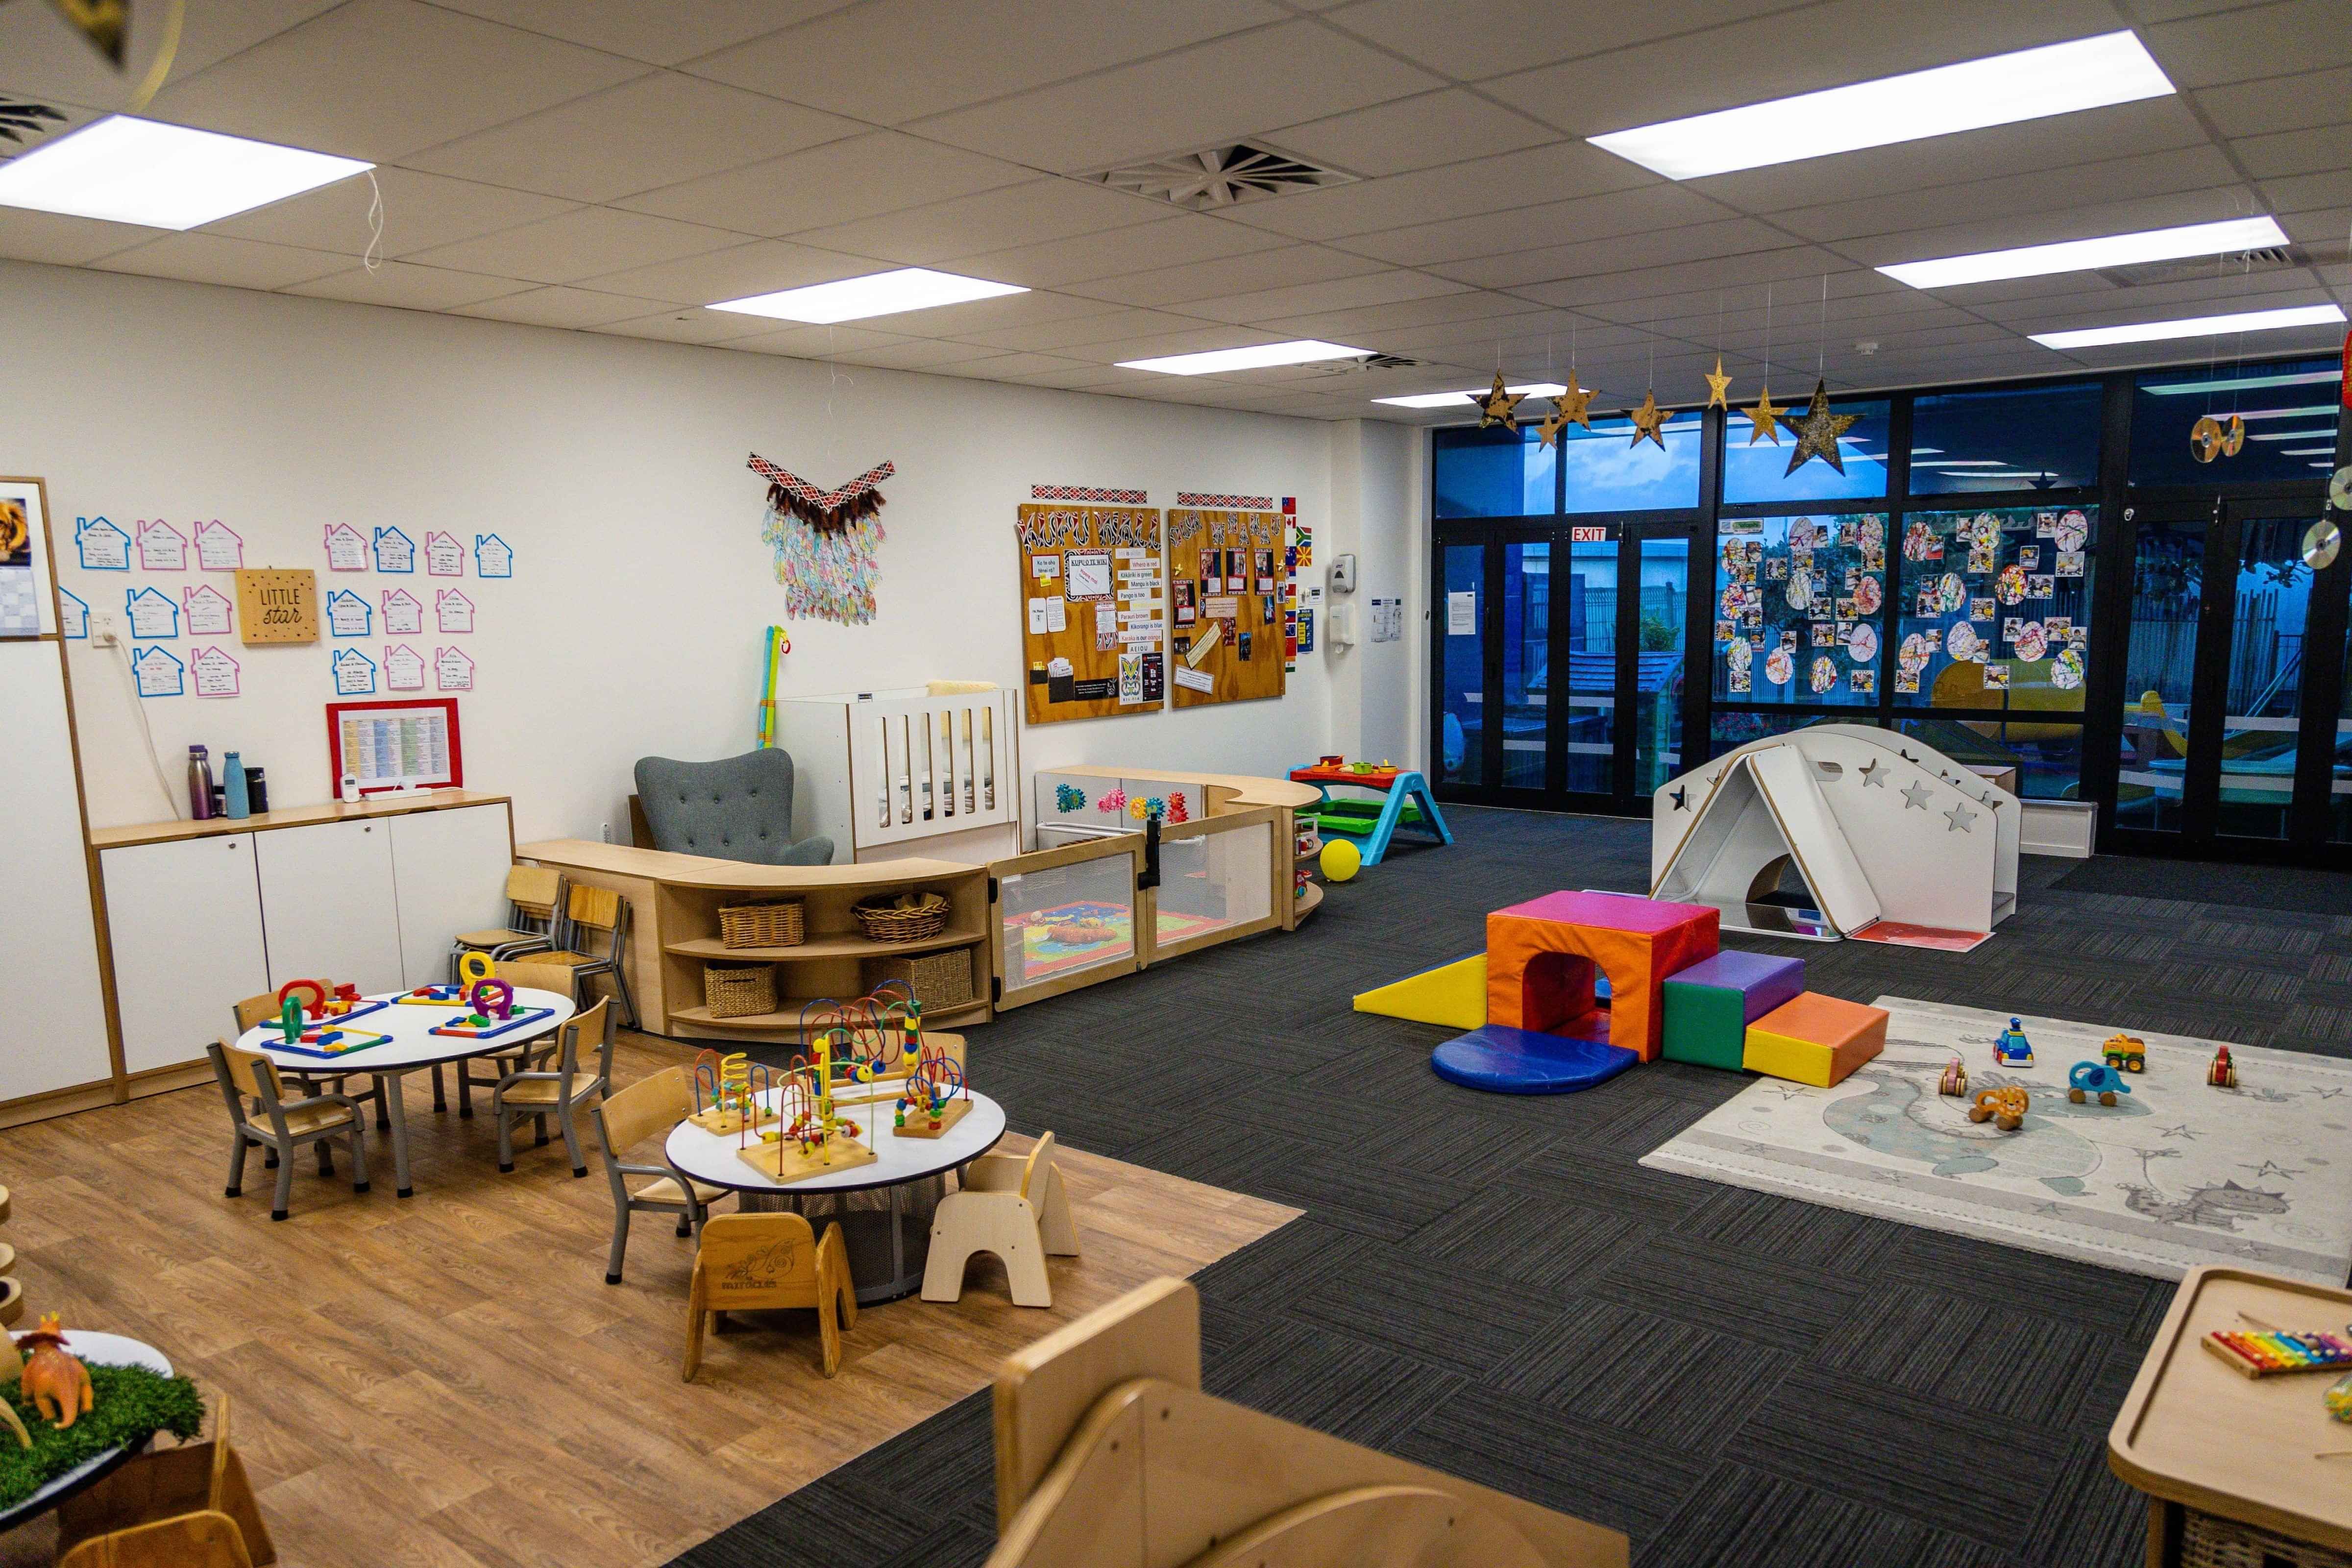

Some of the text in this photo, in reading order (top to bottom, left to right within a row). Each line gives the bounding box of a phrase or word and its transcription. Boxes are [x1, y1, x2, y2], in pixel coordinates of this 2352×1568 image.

[1017, 511, 1161, 555] KUPU WALL
[1574, 528, 1605, 541] EXIT
[260, 588, 301, 605] LITTLE
[263, 606, 302, 624] star
